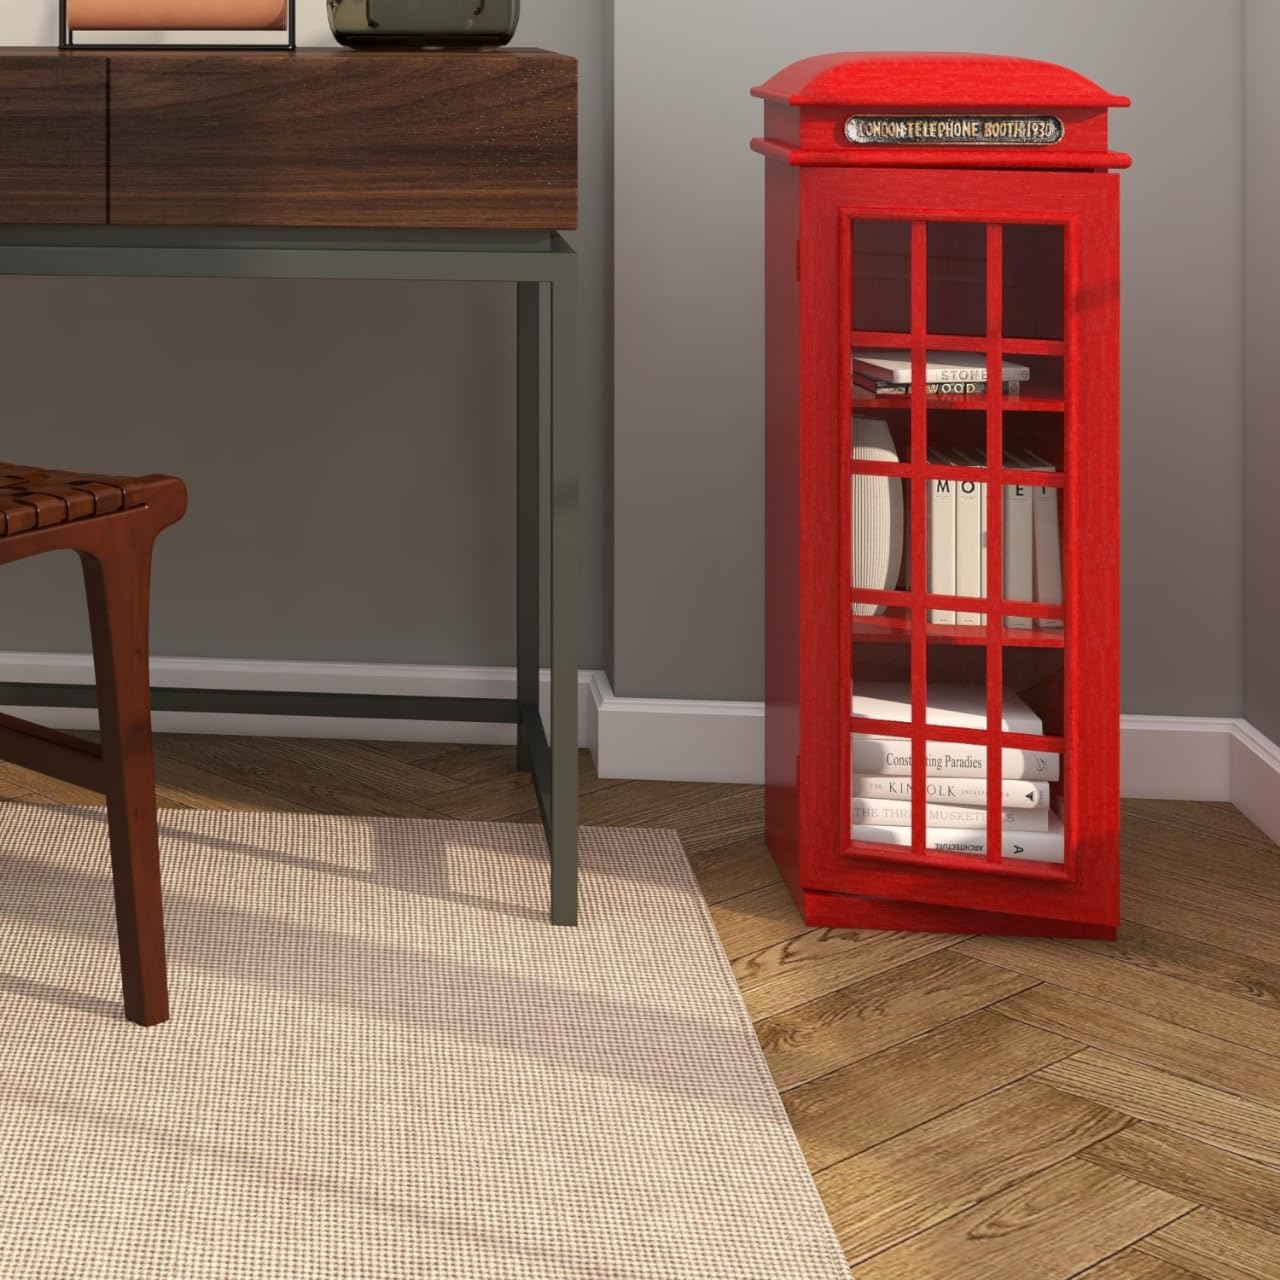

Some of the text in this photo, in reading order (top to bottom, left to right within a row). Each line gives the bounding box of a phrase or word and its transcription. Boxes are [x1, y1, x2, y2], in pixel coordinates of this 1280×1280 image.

[858, 121, 903, 137] LONDON
[905, 121, 979, 137] TELEPHONE
[984, 122, 1021, 137] BOOTH
[945, 755, 982, 768] Paradies
[889, 781, 956, 797] KINOLK
